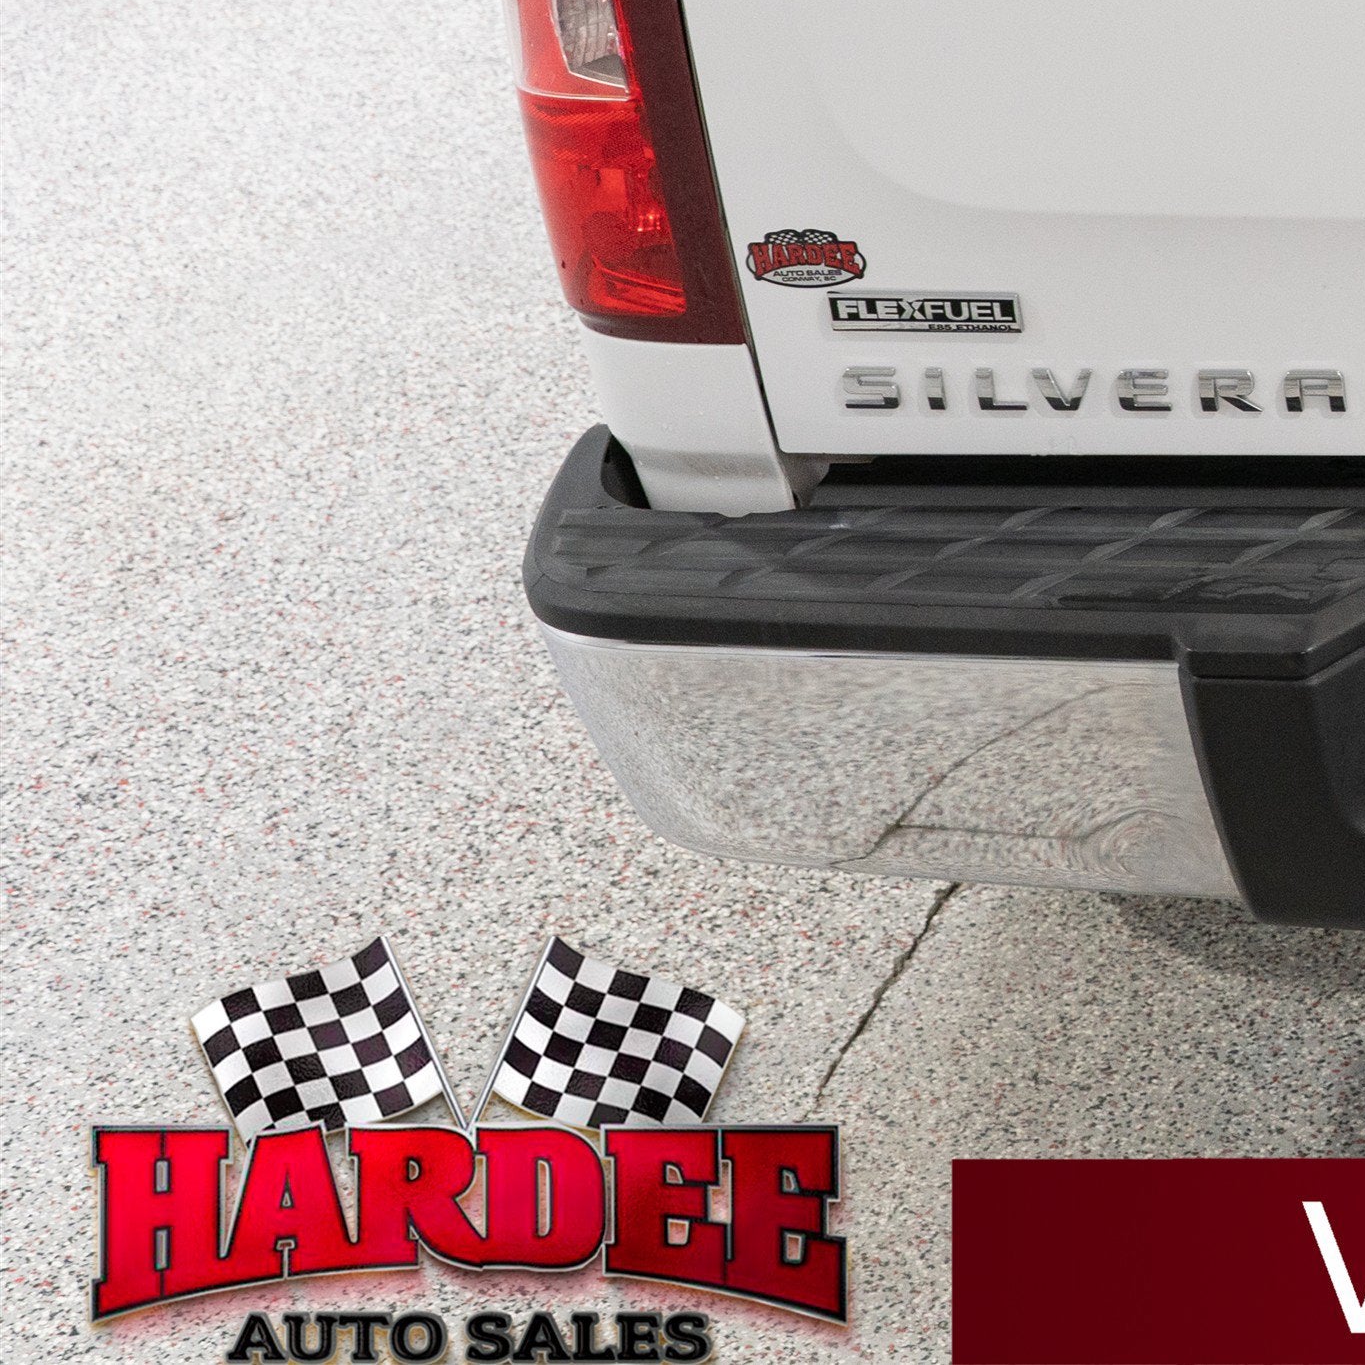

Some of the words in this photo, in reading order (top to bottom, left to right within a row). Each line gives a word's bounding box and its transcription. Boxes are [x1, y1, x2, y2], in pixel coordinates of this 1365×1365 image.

[749, 242, 864, 279] HARDEE
[773, 269, 805, 277] AUTO
[806, 269, 843, 277] SALES
[836, 298, 1014, 322] FLEXFUEL
[928, 323, 953, 332] E85
[955, 324, 1017, 333] ETHANOL
